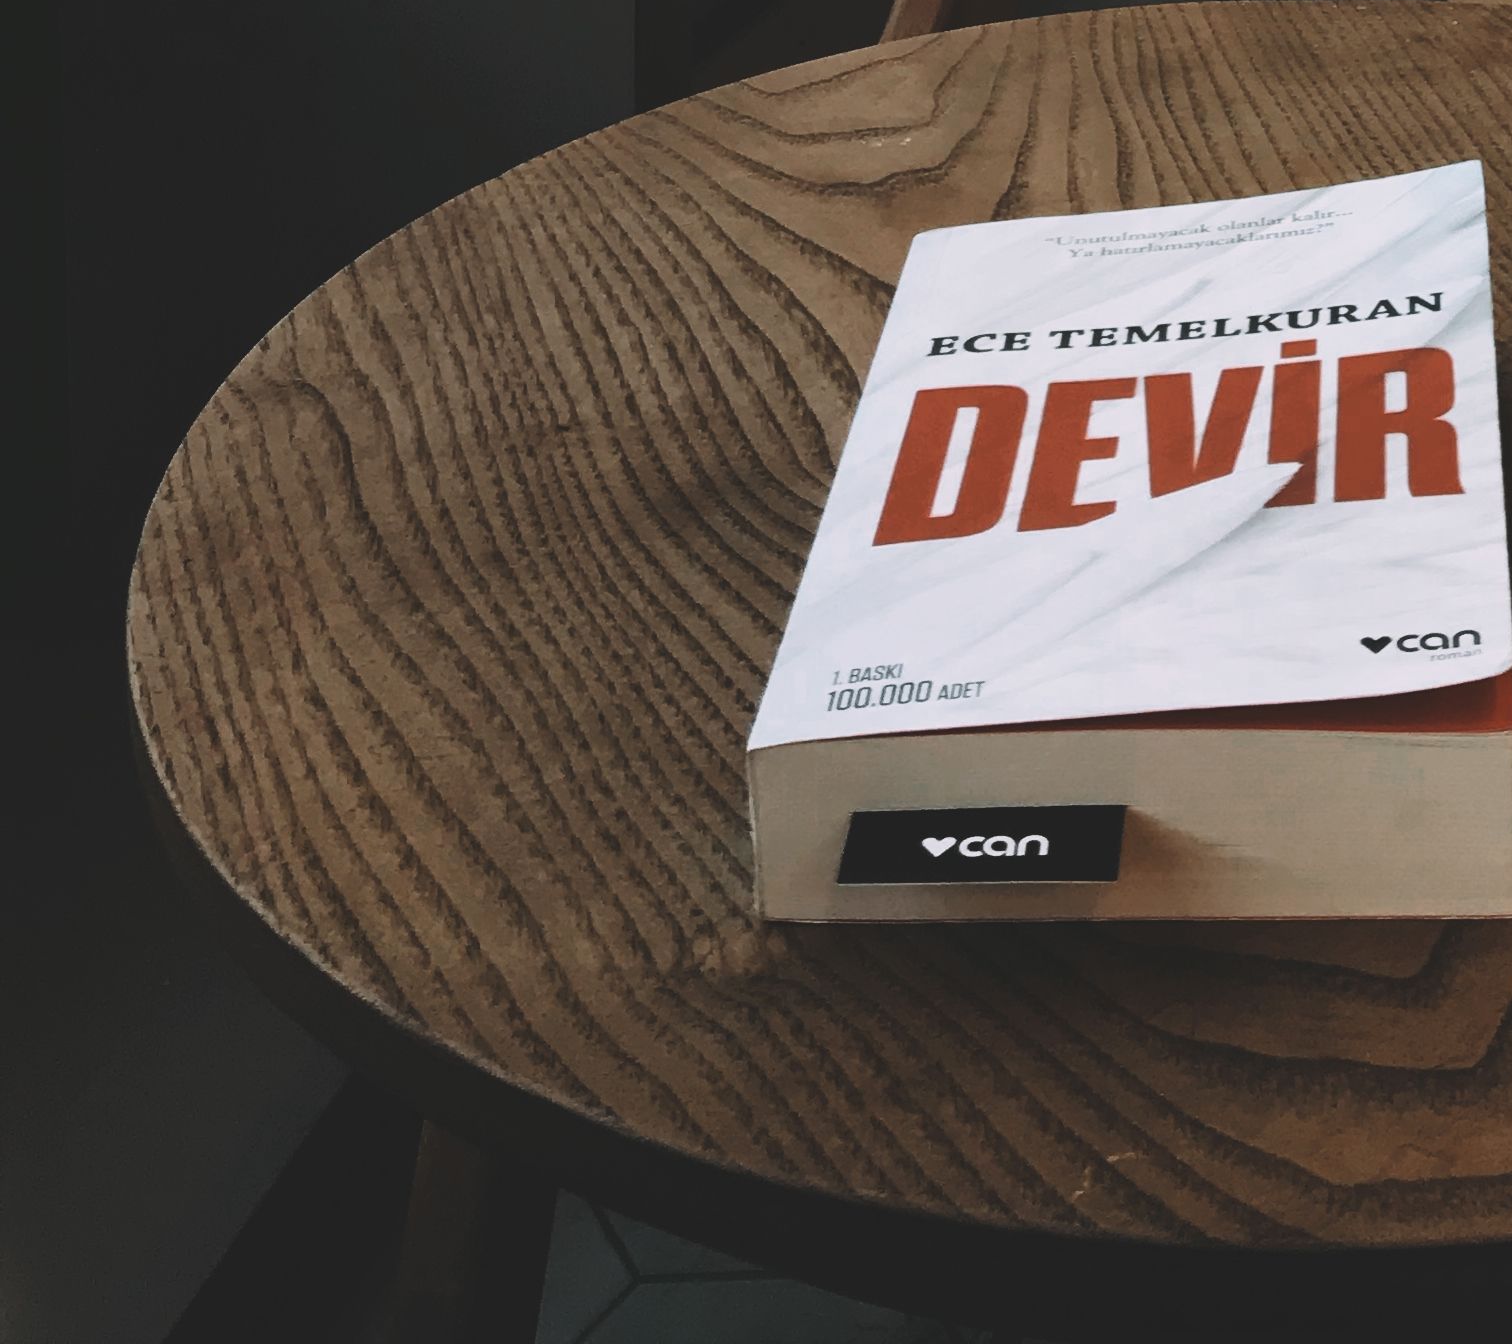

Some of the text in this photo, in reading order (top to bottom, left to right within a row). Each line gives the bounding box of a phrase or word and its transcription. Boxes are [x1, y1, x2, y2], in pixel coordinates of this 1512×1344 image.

[1215, 216, 1285, 232] olanlar
[1068, 246, 1095, 259] Ya
[926, 290, 1446, 358] ECE TEMELKURAN
[872, 340, 1467, 547] DEVİR
[1396, 629, 1482, 653] can
[1429, 649, 1483, 662] roman
[832, 663, 904, 686] 1. BASKI
[825, 678, 986, 713] 100.000 ADET
[959, 830, 1050, 859] can
